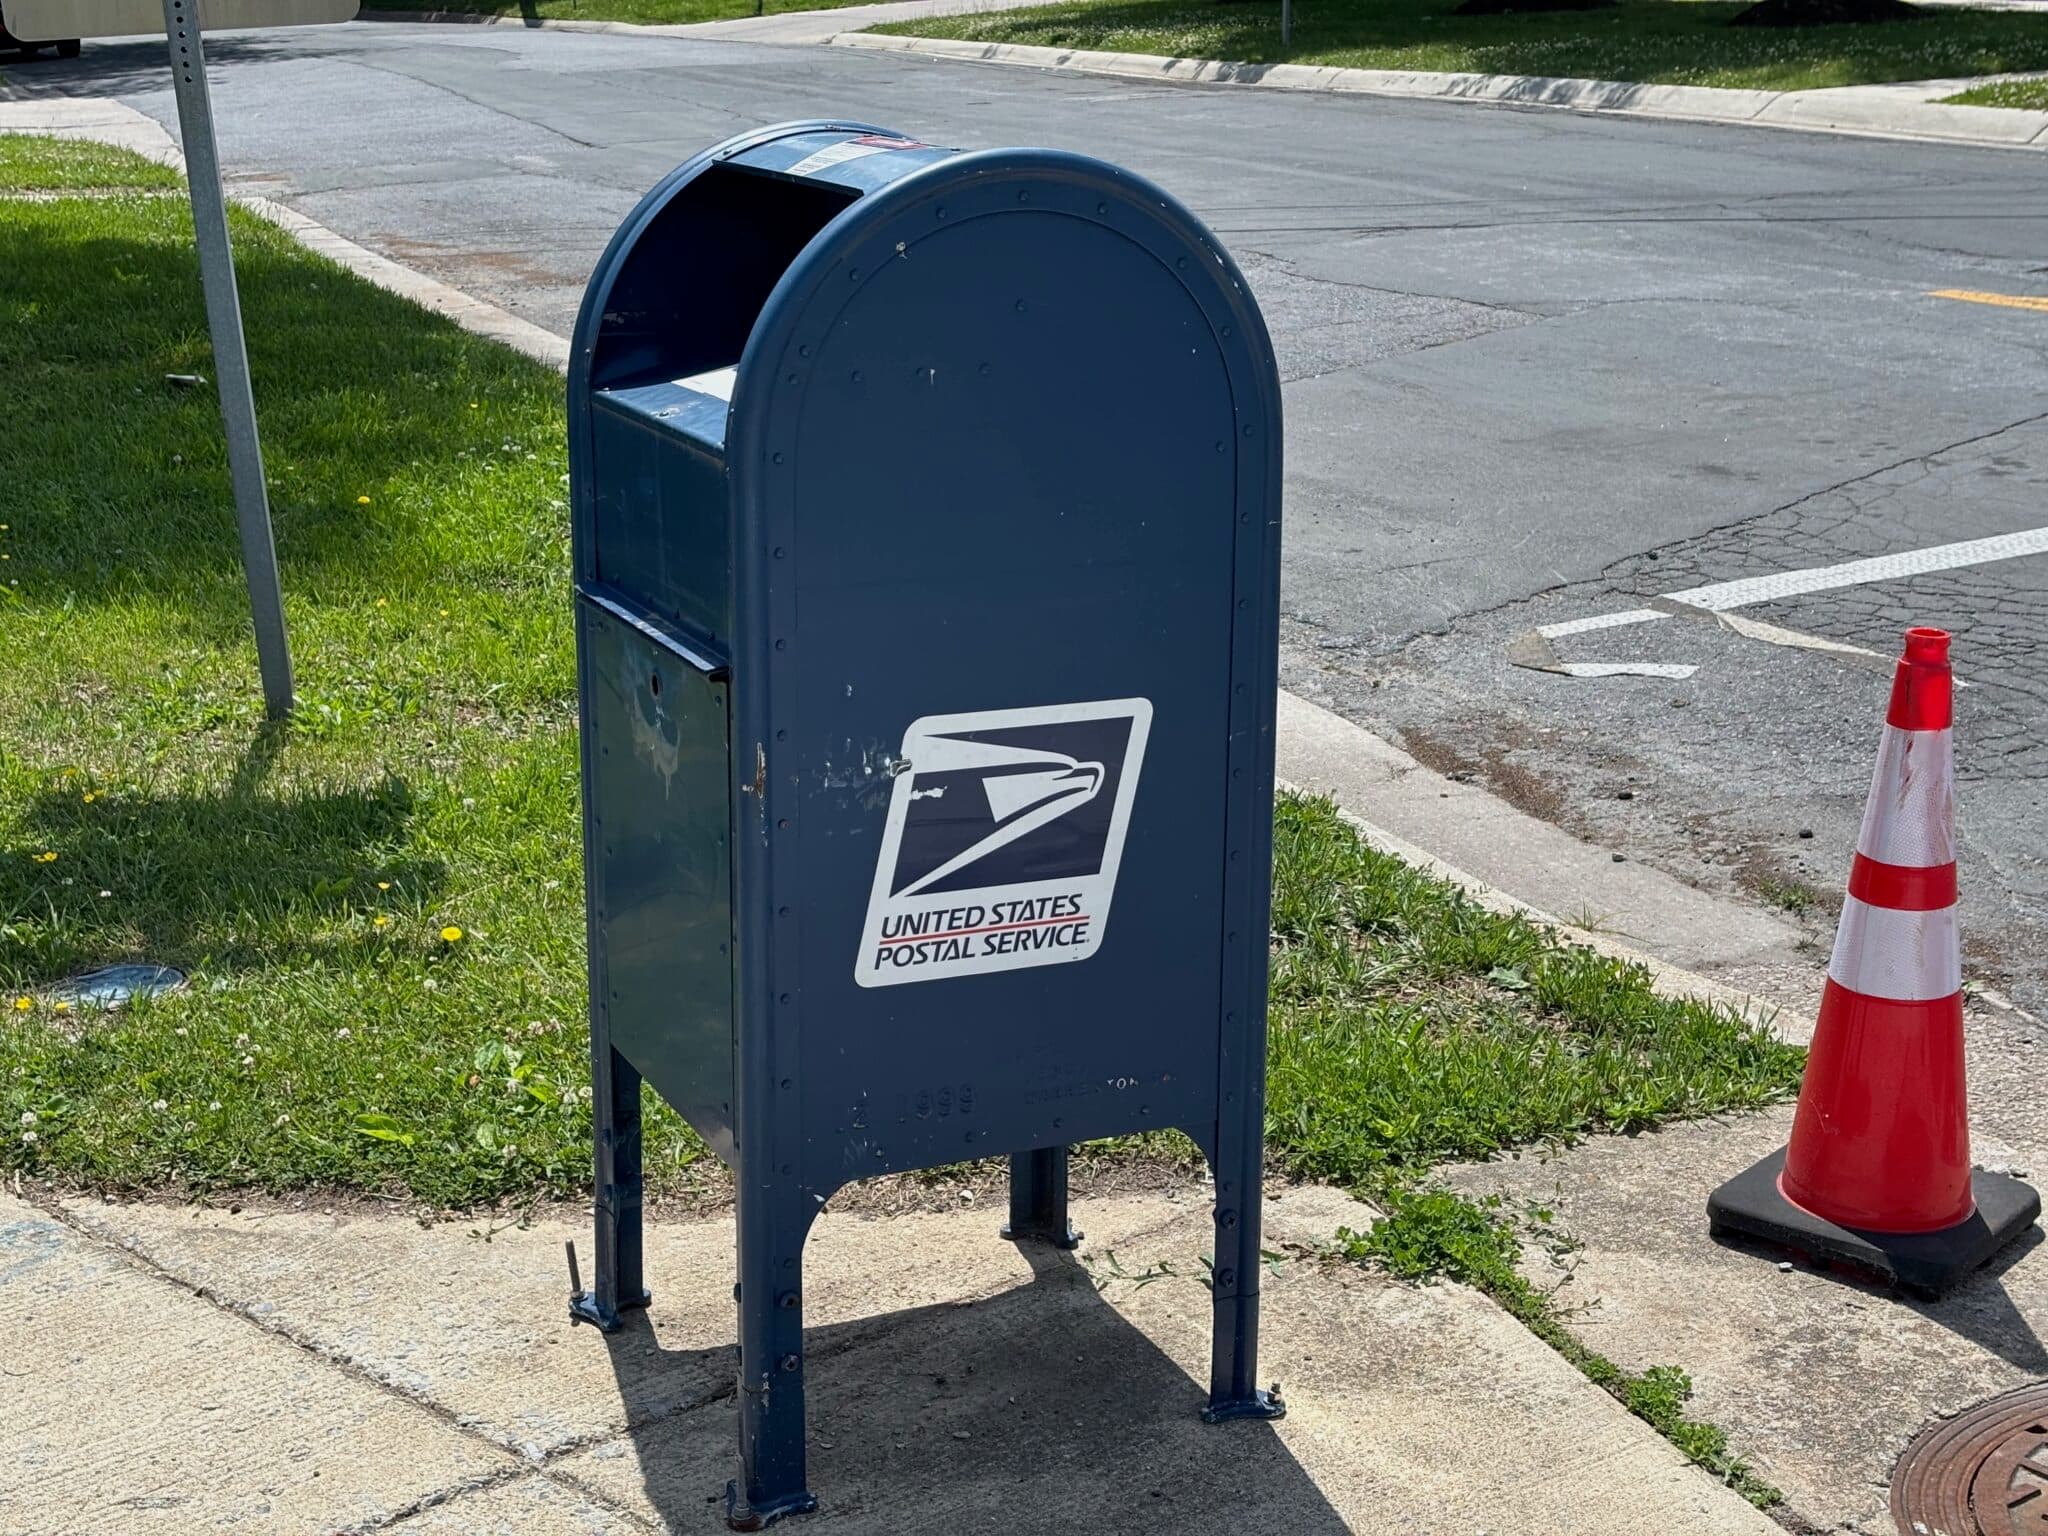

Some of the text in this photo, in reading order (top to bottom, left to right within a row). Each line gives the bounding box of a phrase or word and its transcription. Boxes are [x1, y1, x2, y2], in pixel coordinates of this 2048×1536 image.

[881, 893, 1083, 939] UNITED STATES
[874, 922, 1090, 970] POSTAL SERVICE
